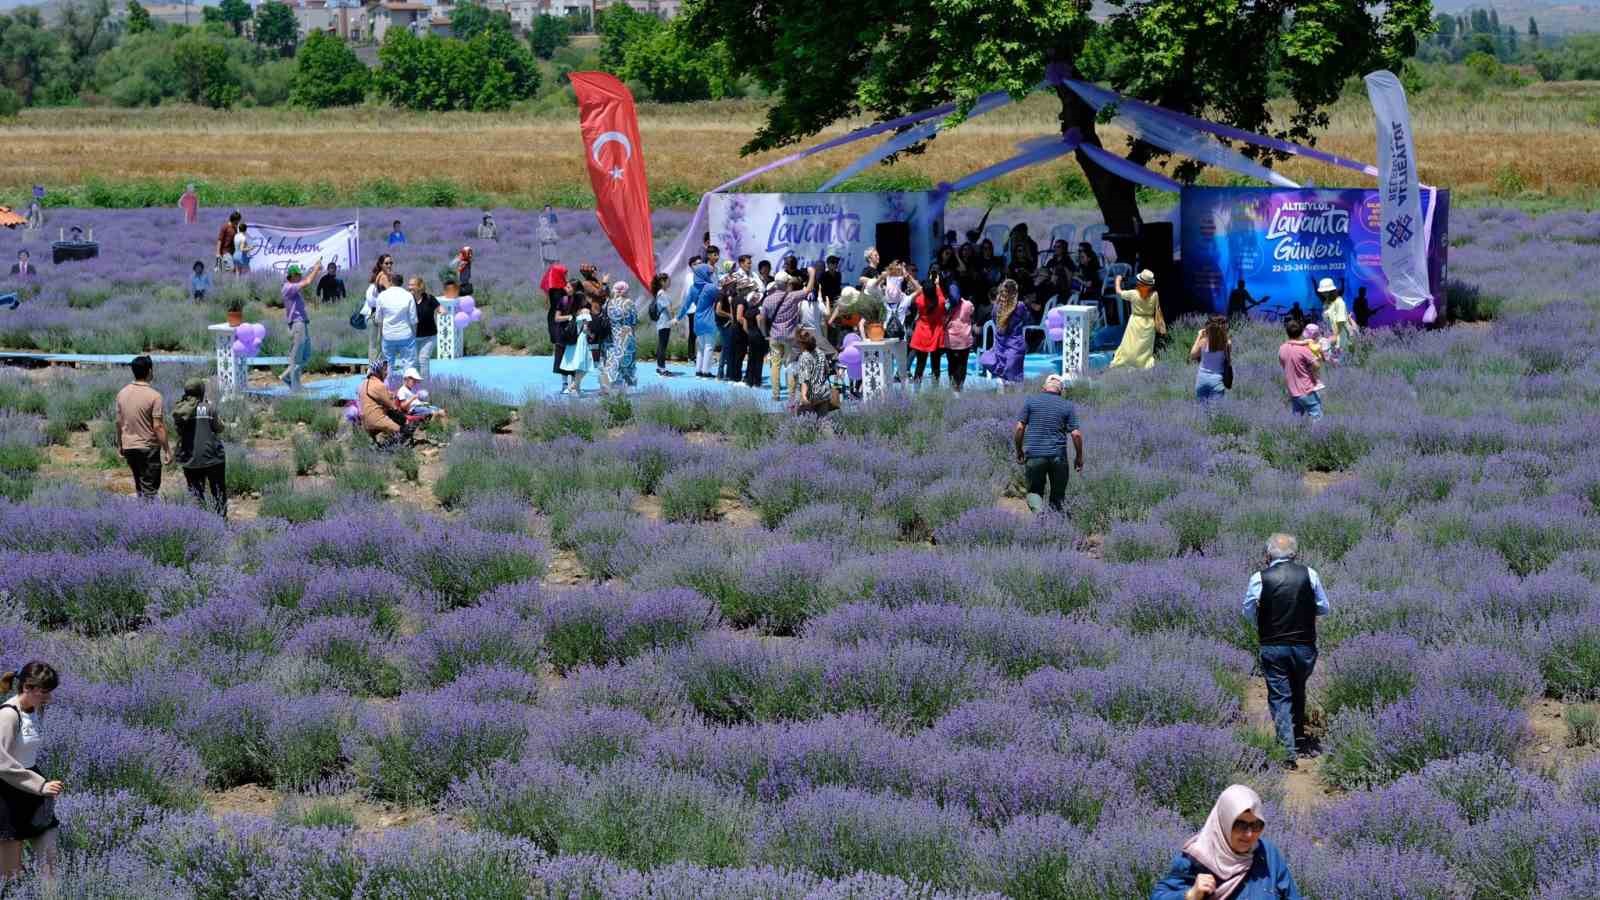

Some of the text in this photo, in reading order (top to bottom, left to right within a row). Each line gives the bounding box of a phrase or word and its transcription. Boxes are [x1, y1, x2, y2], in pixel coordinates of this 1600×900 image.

[766, 207, 861, 252] Lavanta
[1266, 204, 1349, 240] Lavanta
[248, 236, 322, 258] Hababam
[1273, 236, 1343, 261] Günleri
